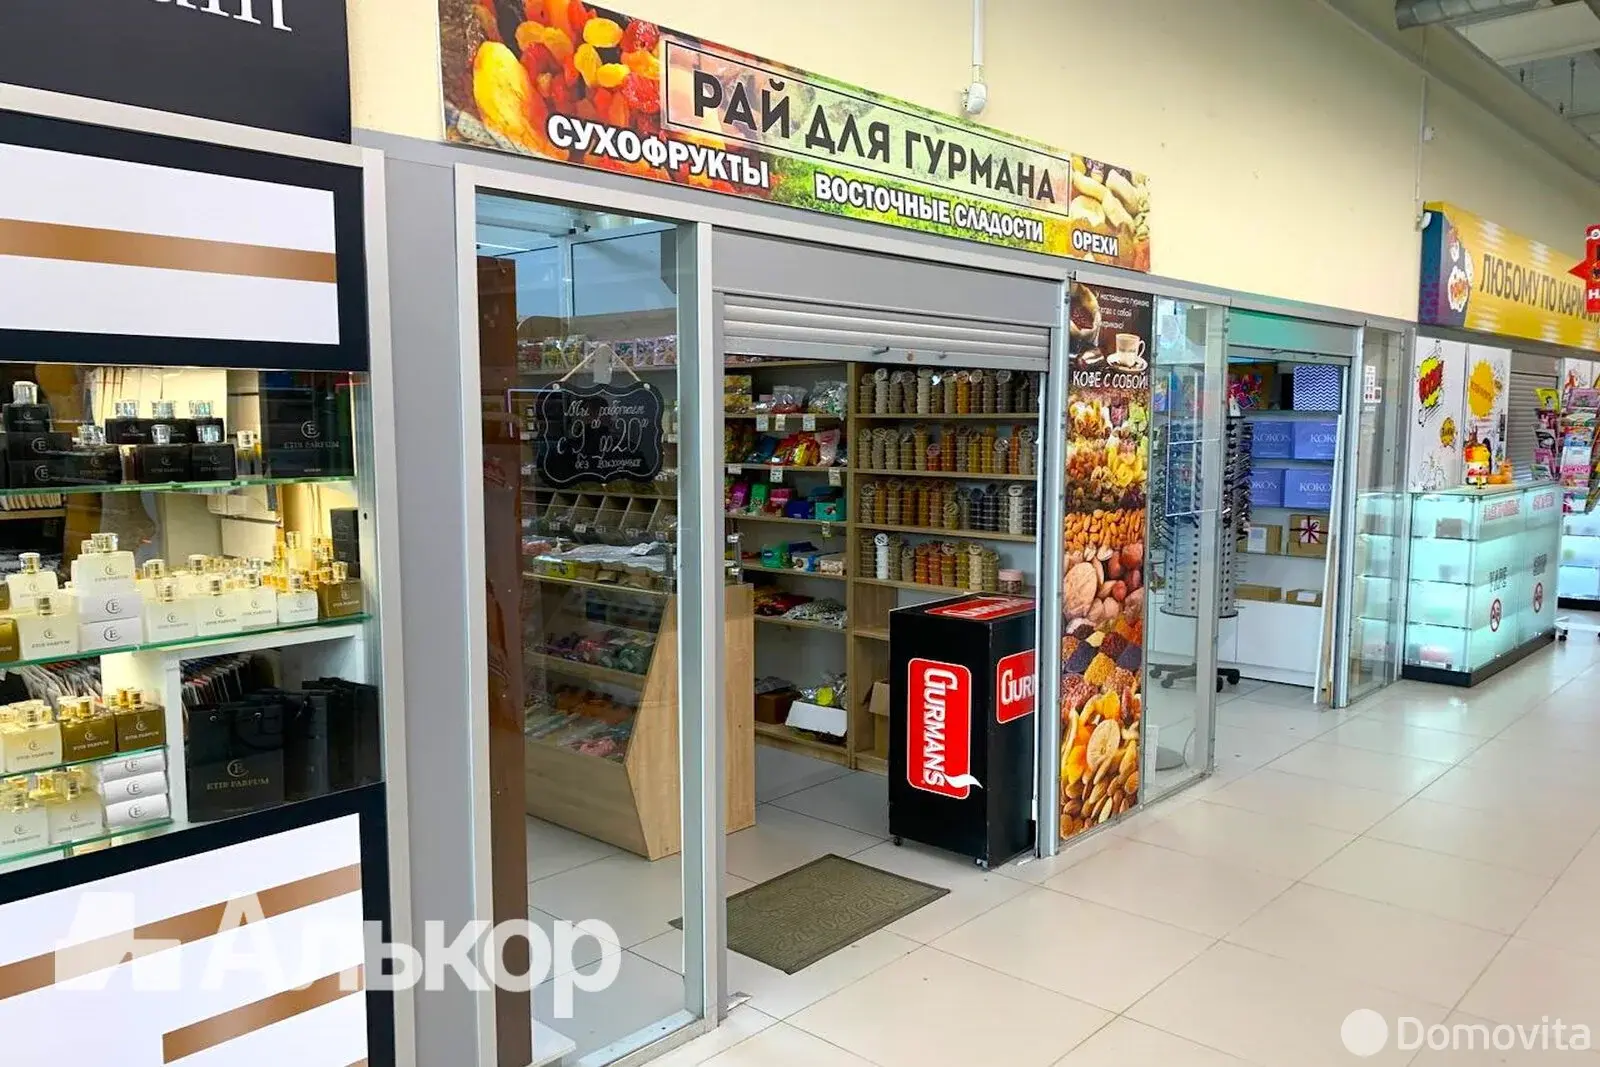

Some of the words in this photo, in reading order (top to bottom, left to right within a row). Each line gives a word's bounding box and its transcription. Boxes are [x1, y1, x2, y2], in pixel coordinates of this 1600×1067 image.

[547, 113, 770, 188] СУХОФРУКТЫ
[692, 69, 790, 139] РАЙ
[805, 104, 890, 163] ДЛЯ
[904, 129, 1056, 204] ГУРМАНА
[814, 172, 951, 226] ВОСТОЧНЫЕ
[953, 203, 1045, 243] СЛАДОСТИ
[1072, 229, 1119, 256] ОРЕХИ
[1480, 253, 1540, 307] ЛЮБОМУ
[1541, 274, 1558, 312] ПО
[1073, 370, 1102, 388] КОФЕ
[1104, 373, 1111, 388] С
[923, 668, 958, 787] GURMANS
